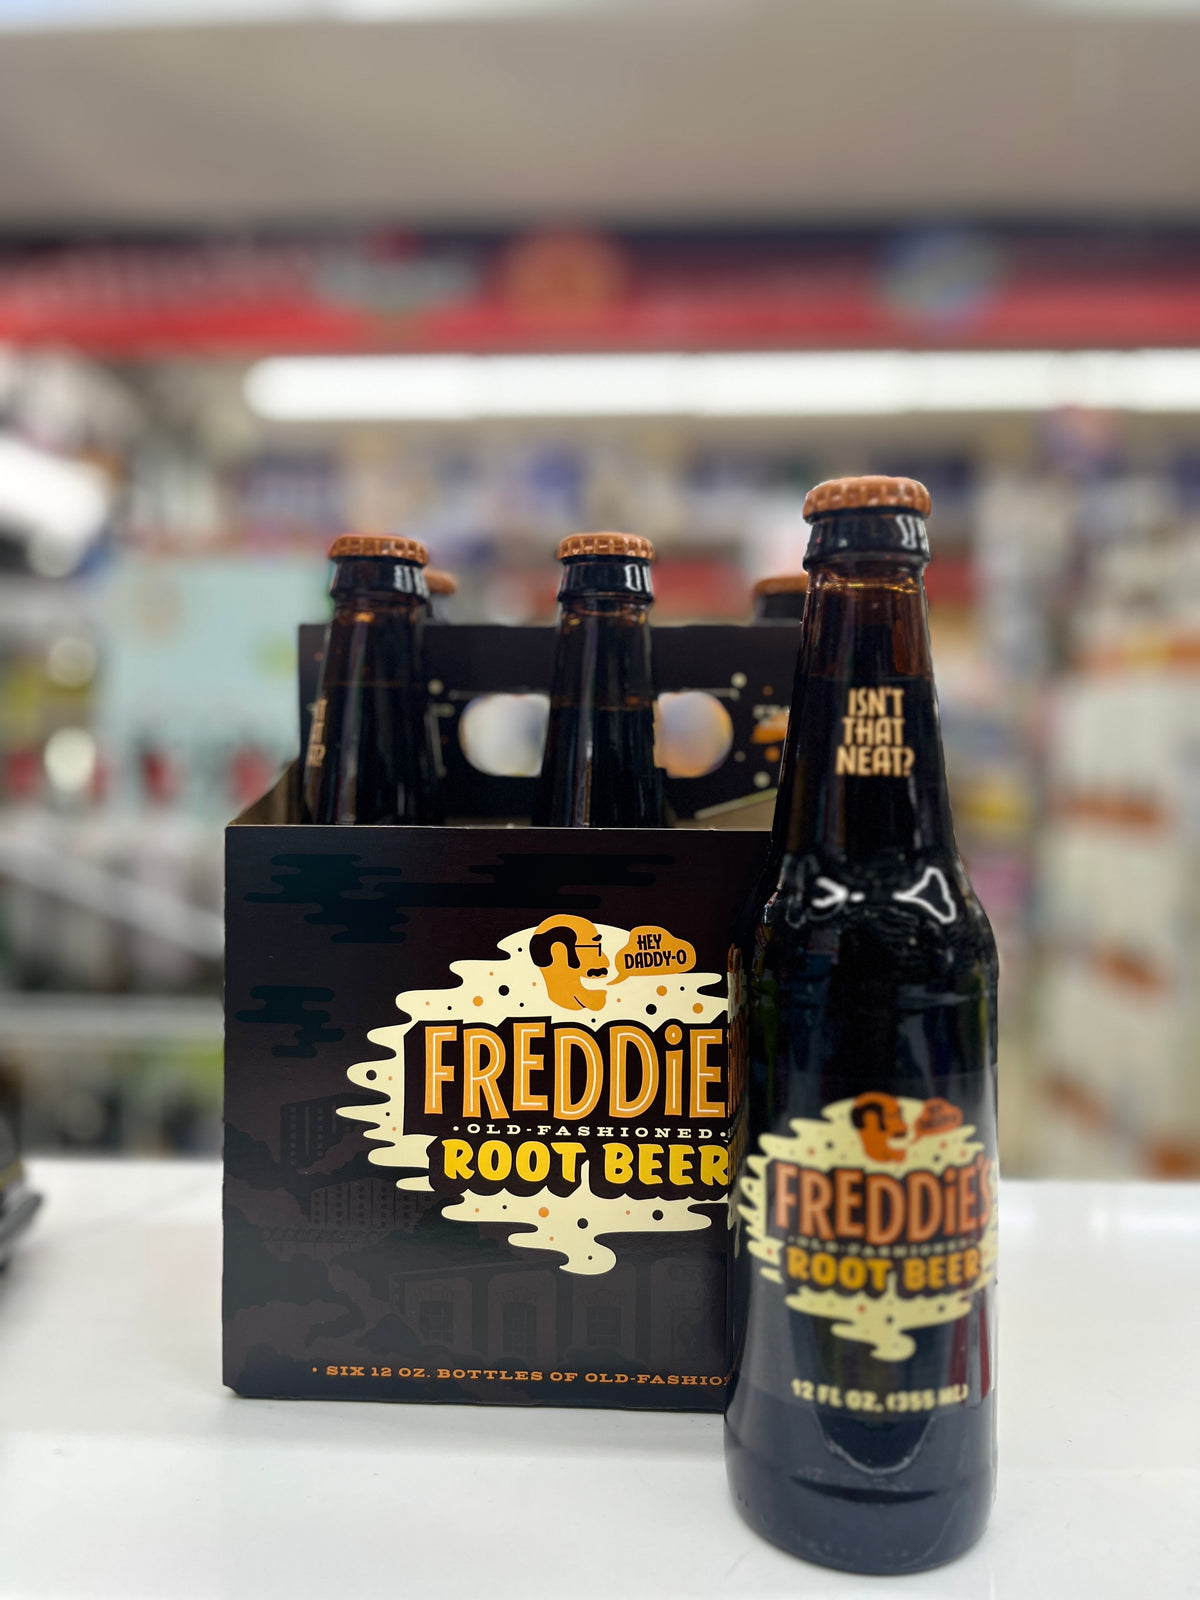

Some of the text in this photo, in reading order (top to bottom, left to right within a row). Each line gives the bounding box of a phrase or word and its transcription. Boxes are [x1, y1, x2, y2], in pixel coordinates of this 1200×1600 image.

[848, 686, 905, 718] ISN'T
[842, 717, 906, 746] THAT
[836, 745, 916, 778] NEAT?
[637, 933, 661, 951] HEY
[624, 949, 686, 969] DADDY-O
[424, 1022, 729, 1119] FREDDiE
[467, 1123, 712, 1138] OLD-FASHIONED
[441, 1139, 729, 1186] ROOT BEER
[786, 1246, 893, 1291] ROOT
[903, 1247, 982, 1290] BEER
[326, 1365, 365, 1376] SIX
[371, 1367, 392, 1377] 12
[399, 1368, 430, 1378] OZ.
[437, 1369, 543, 1381] BOTTLES
[550, 1372, 578, 1382] OF
[791, 1379, 814, 1400] 12
[817, 1384, 842, 1408] FL
[845, 1389, 884, 1413] OZ.
